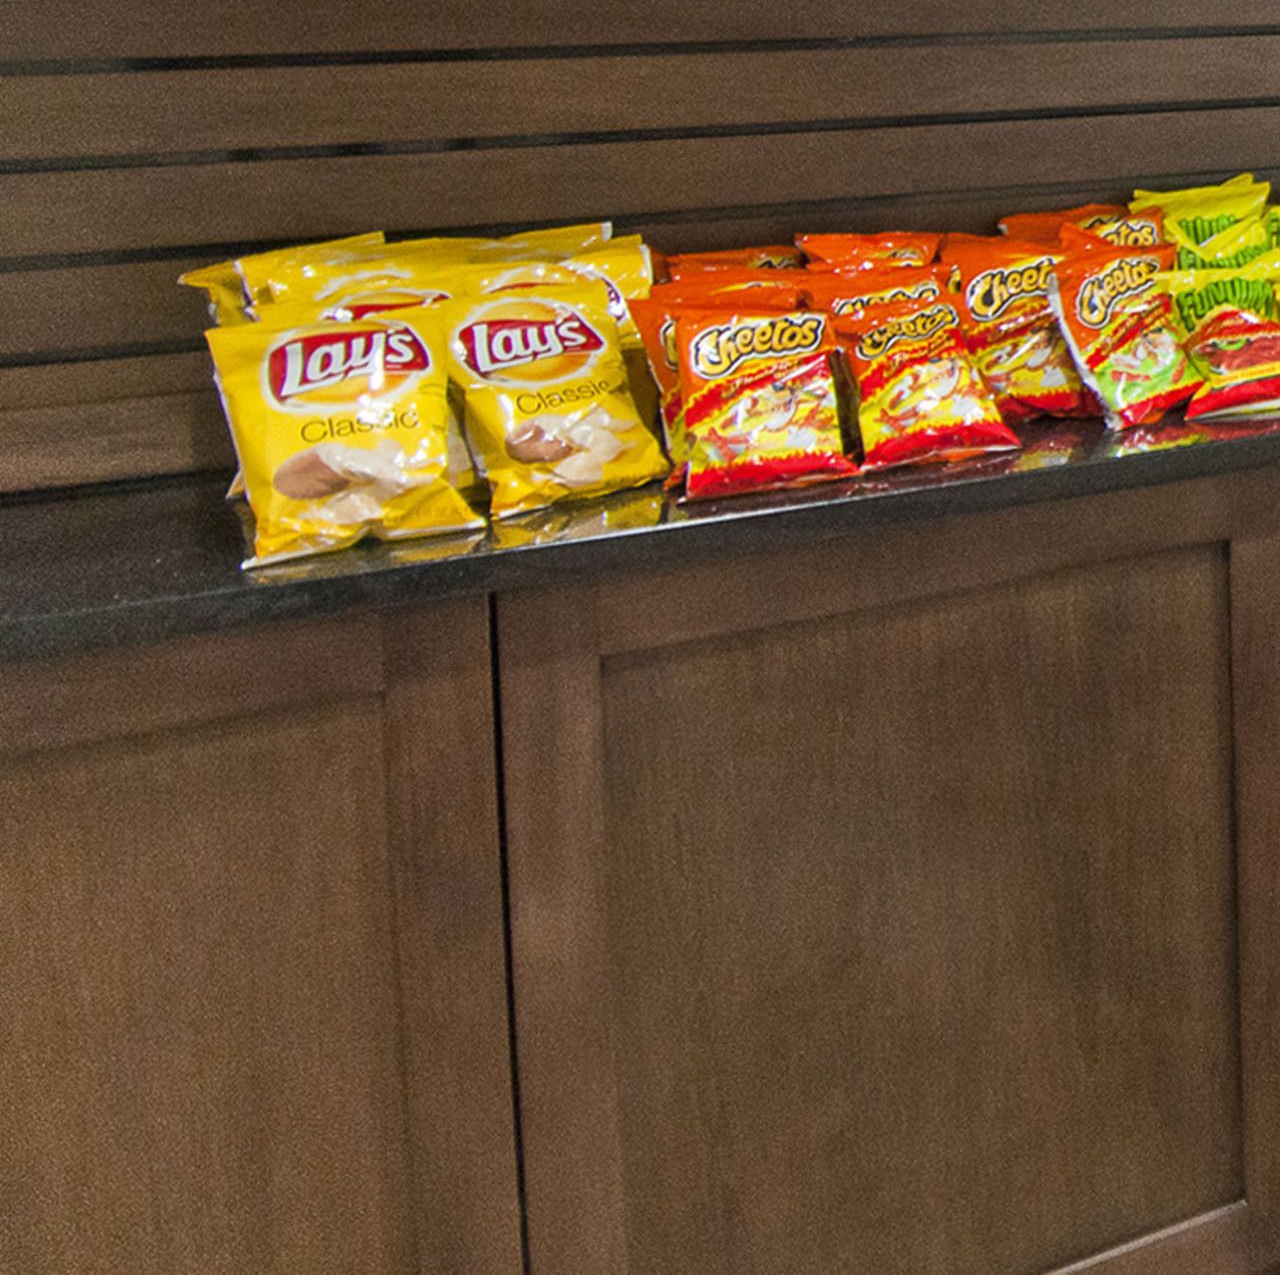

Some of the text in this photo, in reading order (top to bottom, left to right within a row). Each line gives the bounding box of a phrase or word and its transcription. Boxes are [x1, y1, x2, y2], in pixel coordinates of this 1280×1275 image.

[967, 257, 1054, 321] Cheet
[280, 326, 418, 398] Lay's
[472, 318, 594, 377] Lay's
[694, 314, 824, 378] Cheetos
[300, 406, 420, 445] Classic
[515, 379, 612, 417] Classic
